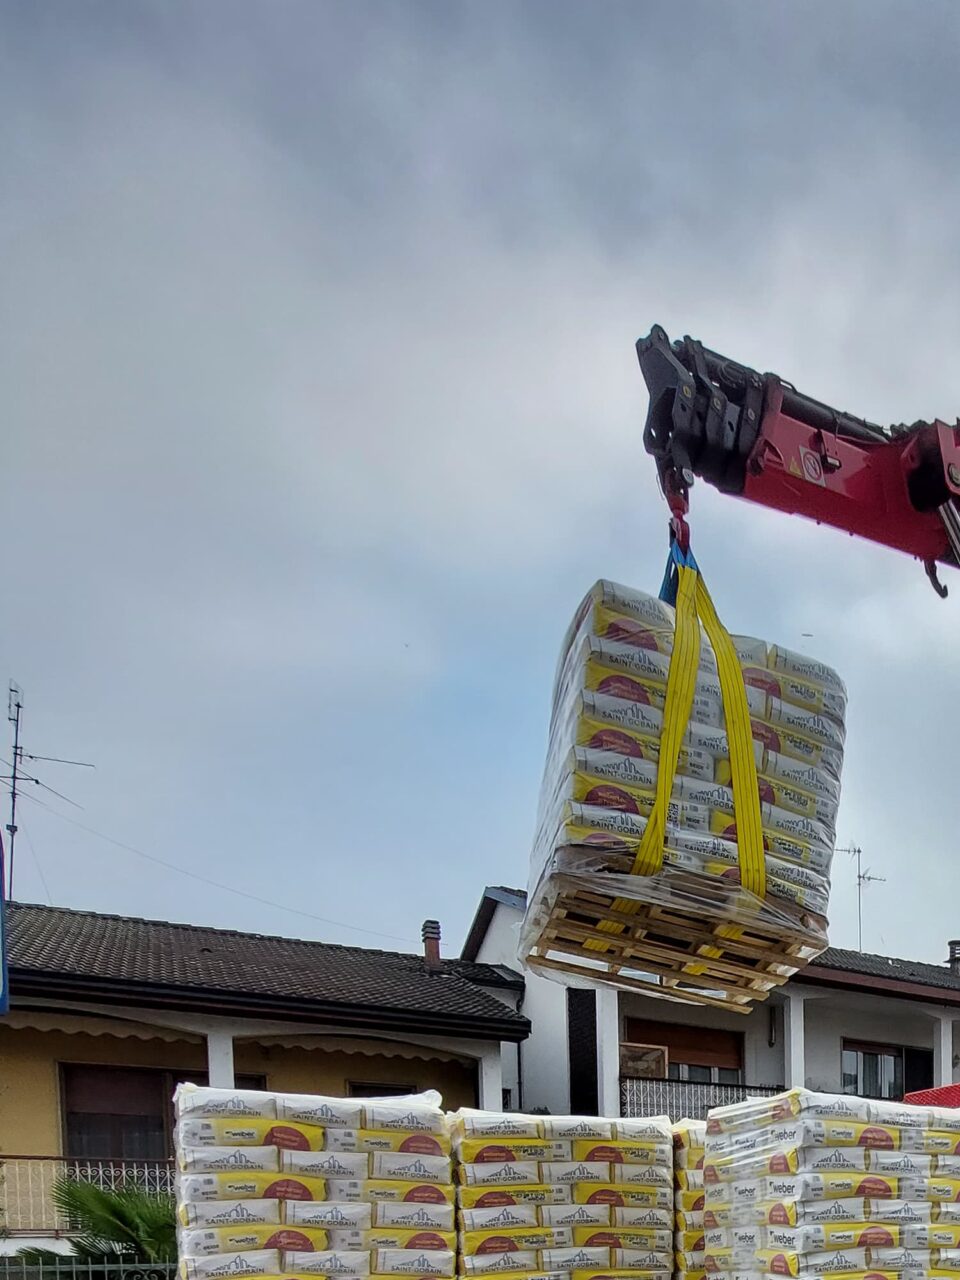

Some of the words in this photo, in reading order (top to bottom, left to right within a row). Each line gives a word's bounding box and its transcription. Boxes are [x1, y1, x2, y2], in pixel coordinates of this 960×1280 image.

[609, 655, 665, 676] SAINT-GOBAIN
[602, 711, 659, 730] SAINT-GOBAIN
[594, 766, 652, 785] SAINT-GOBAIN
[689, 792, 735, 810] SAINT-GOBA
[590, 820, 643, 835] SAINT-GOBAI
[387, 1170, 438, 1180] SAINT-GOBAIN
[773, 1181, 796, 1194] weber
[391, 1220, 441, 1228] SAINT-GOBAIN
[774, 1233, 796, 1245] weber
